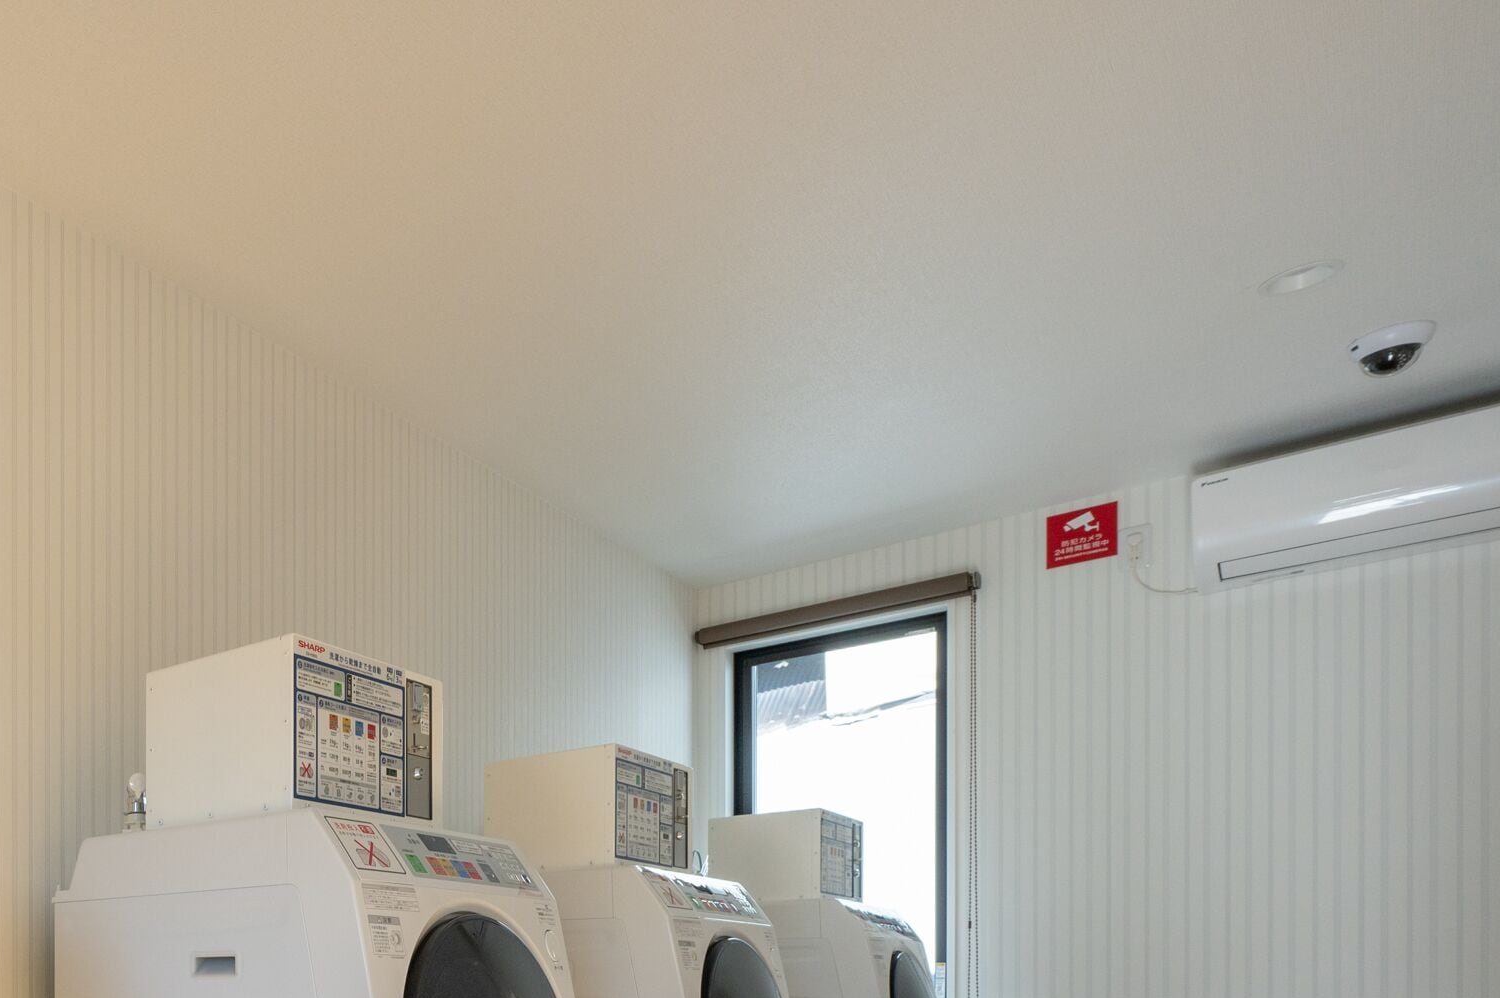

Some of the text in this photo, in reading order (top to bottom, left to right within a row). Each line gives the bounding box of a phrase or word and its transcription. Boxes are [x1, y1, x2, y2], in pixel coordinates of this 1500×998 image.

[1061, 533, 1103, 548] 防犯カメラ
[298, 639, 325, 654] SHARP
